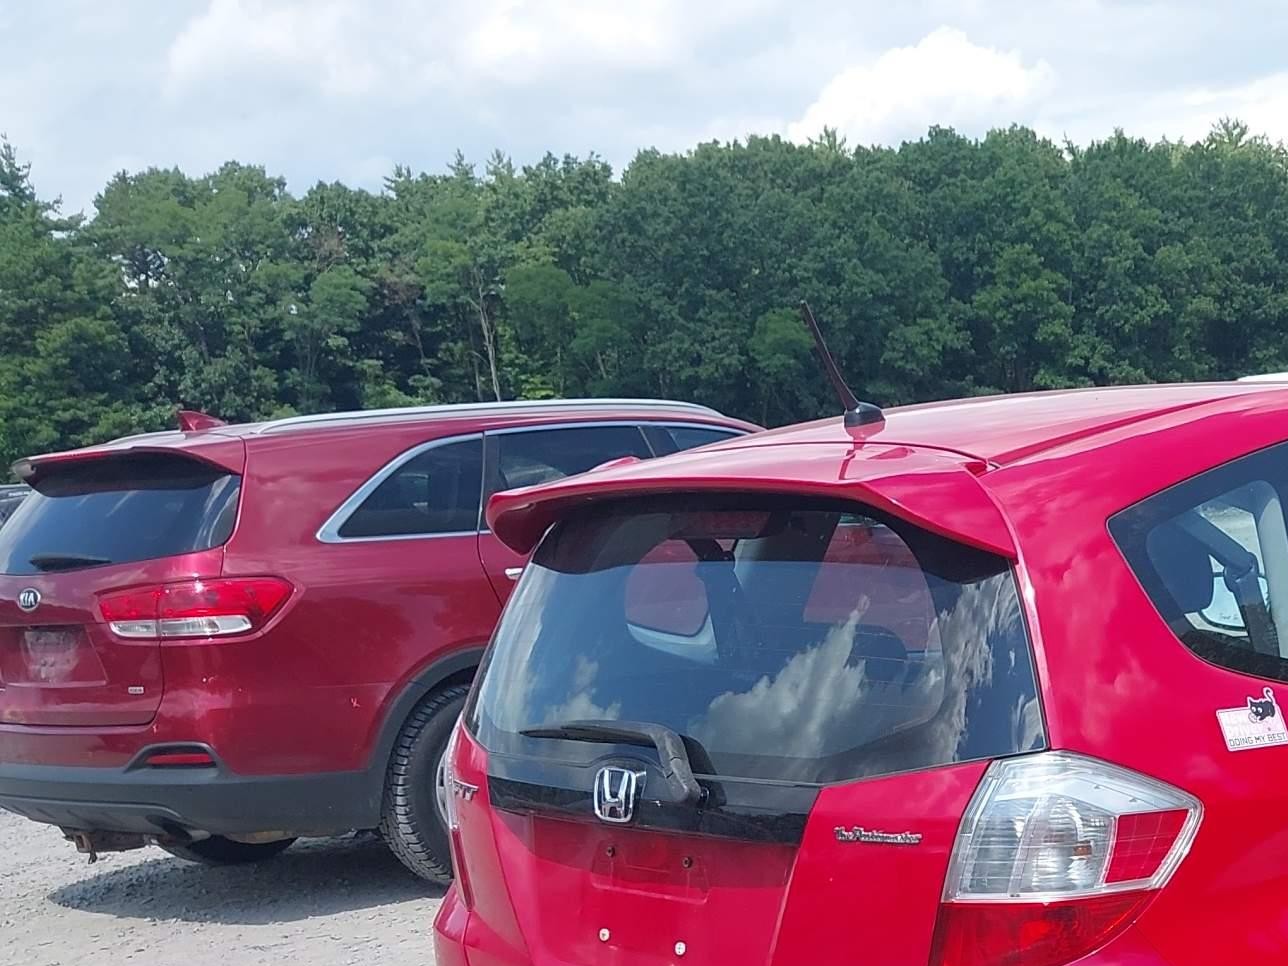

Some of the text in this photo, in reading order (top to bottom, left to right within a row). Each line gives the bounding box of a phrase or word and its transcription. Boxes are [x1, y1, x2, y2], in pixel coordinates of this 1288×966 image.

[20, 592, 36, 607] KIA
[1229, 732, 1286, 747] DOING MY BEST
